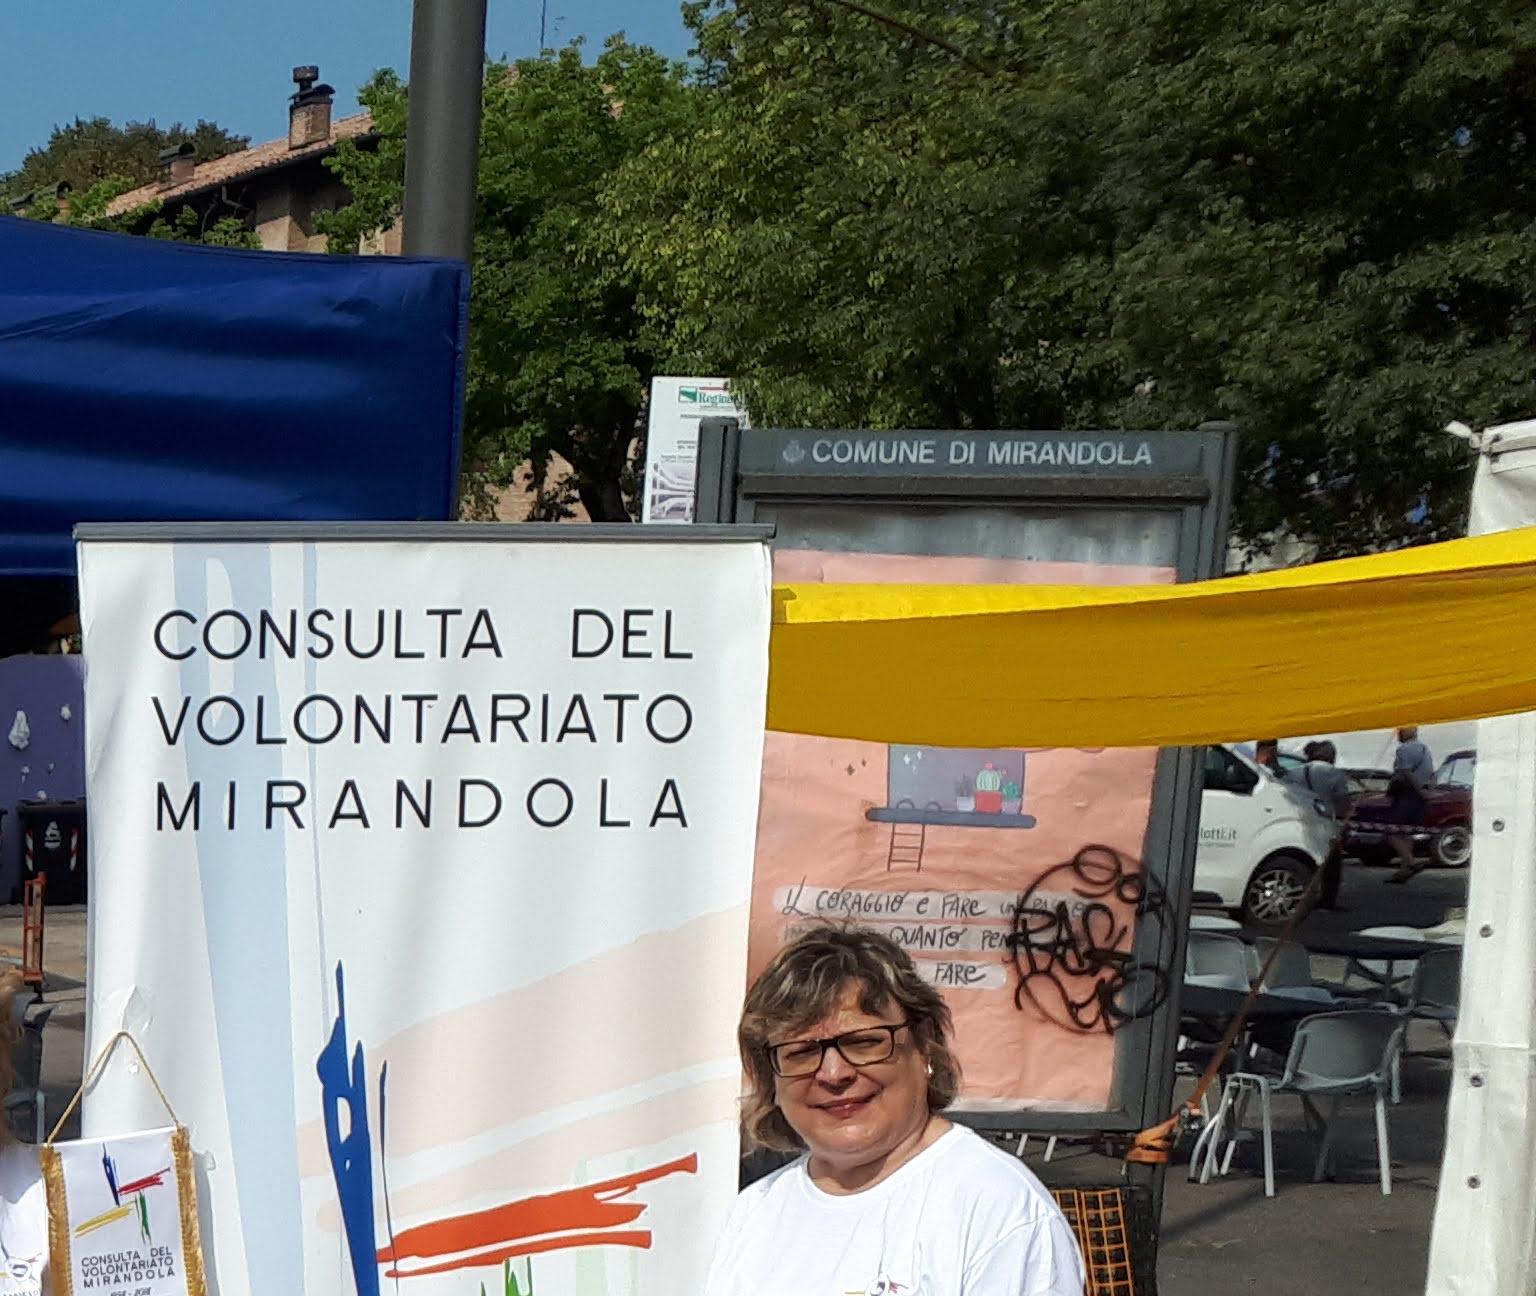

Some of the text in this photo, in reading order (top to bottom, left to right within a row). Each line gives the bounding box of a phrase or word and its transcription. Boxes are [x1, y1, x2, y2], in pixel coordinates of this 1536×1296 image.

[812, 439, 1153, 466] COMUNE DI MIRANDOLA
[153, 608, 694, 661] CONSULTA DEL
[150, 693, 694, 746] VOLONTARIATO
[155, 778, 689, 832] MIRANDOLA
[81, 1246, 173, 1267] CONSULTA DEL
[81, 1256, 174, 1278] VOLONTARIATO
[83, 1267, 176, 1289] MIRANDOLA
